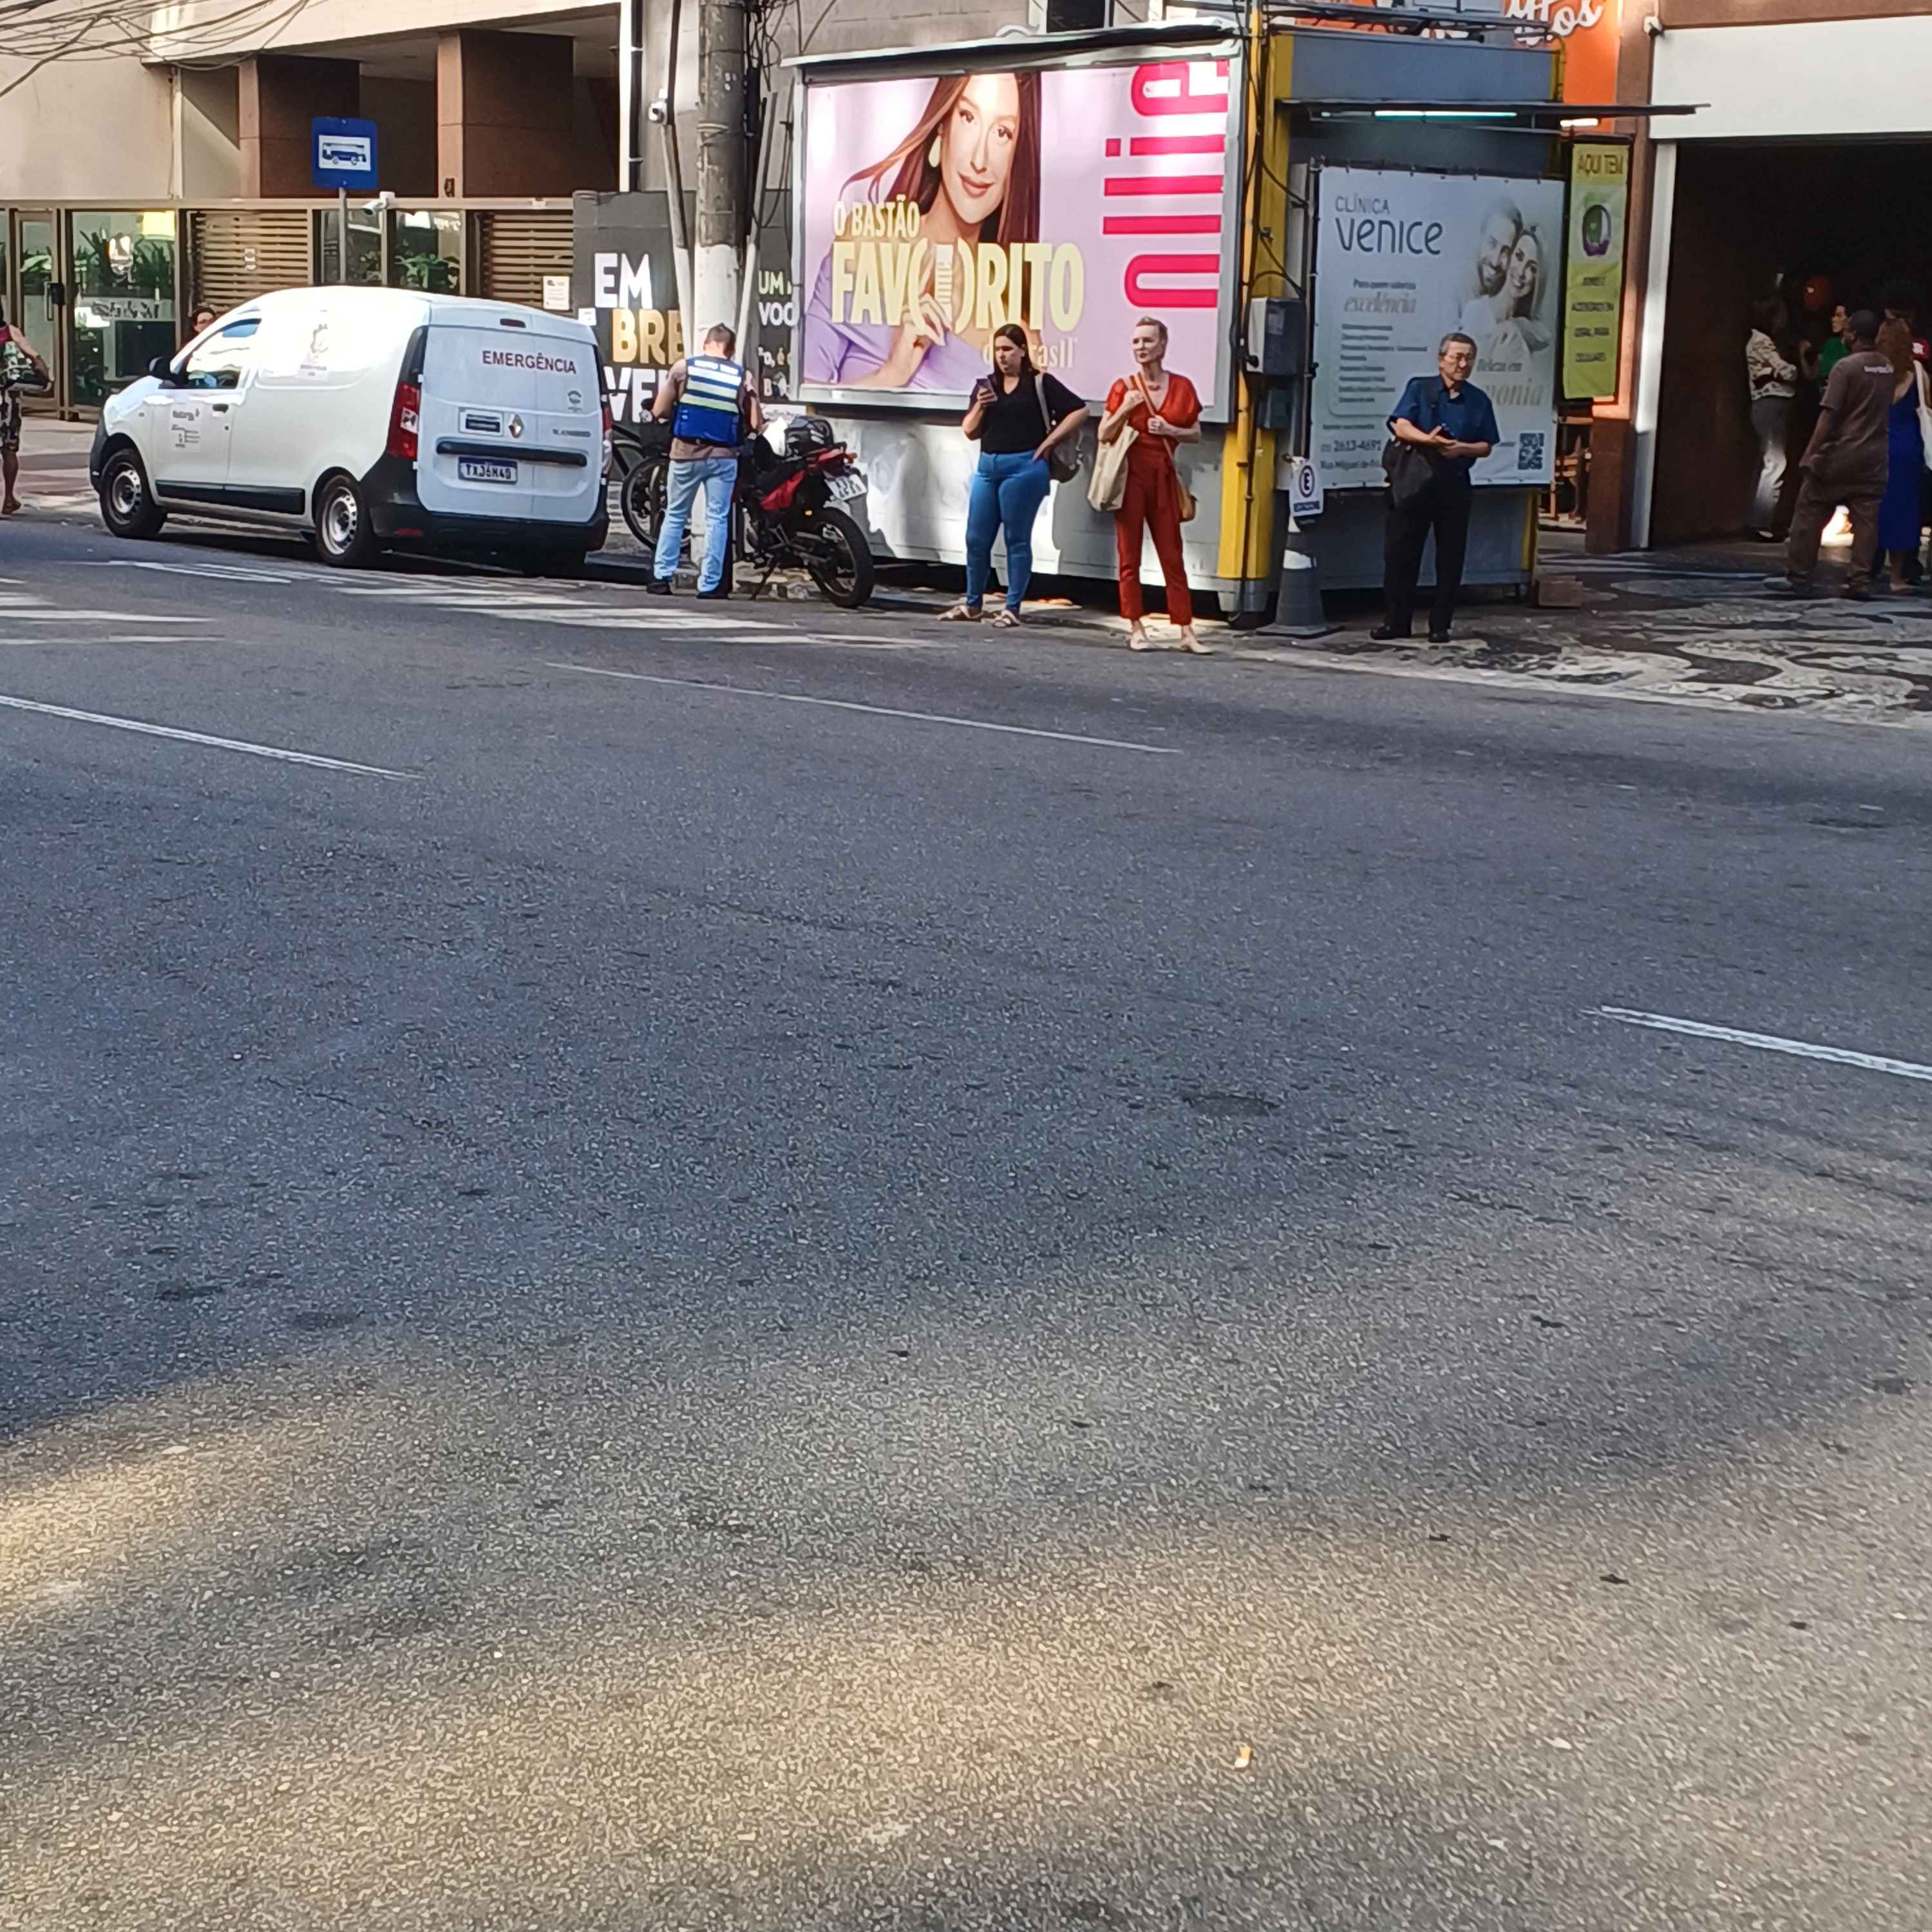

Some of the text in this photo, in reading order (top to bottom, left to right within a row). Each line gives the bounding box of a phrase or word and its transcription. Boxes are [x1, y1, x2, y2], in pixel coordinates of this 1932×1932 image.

[833, 194, 920, 238] O BASTÃO
[1334, 193, 1390, 214] CLÍNICA
[594, 252, 653, 310] EM
[759, 270, 784, 295] UM
[482, 350, 577, 375] EMERGÊNCIA
[1029, 337, 1074, 368] rasil
